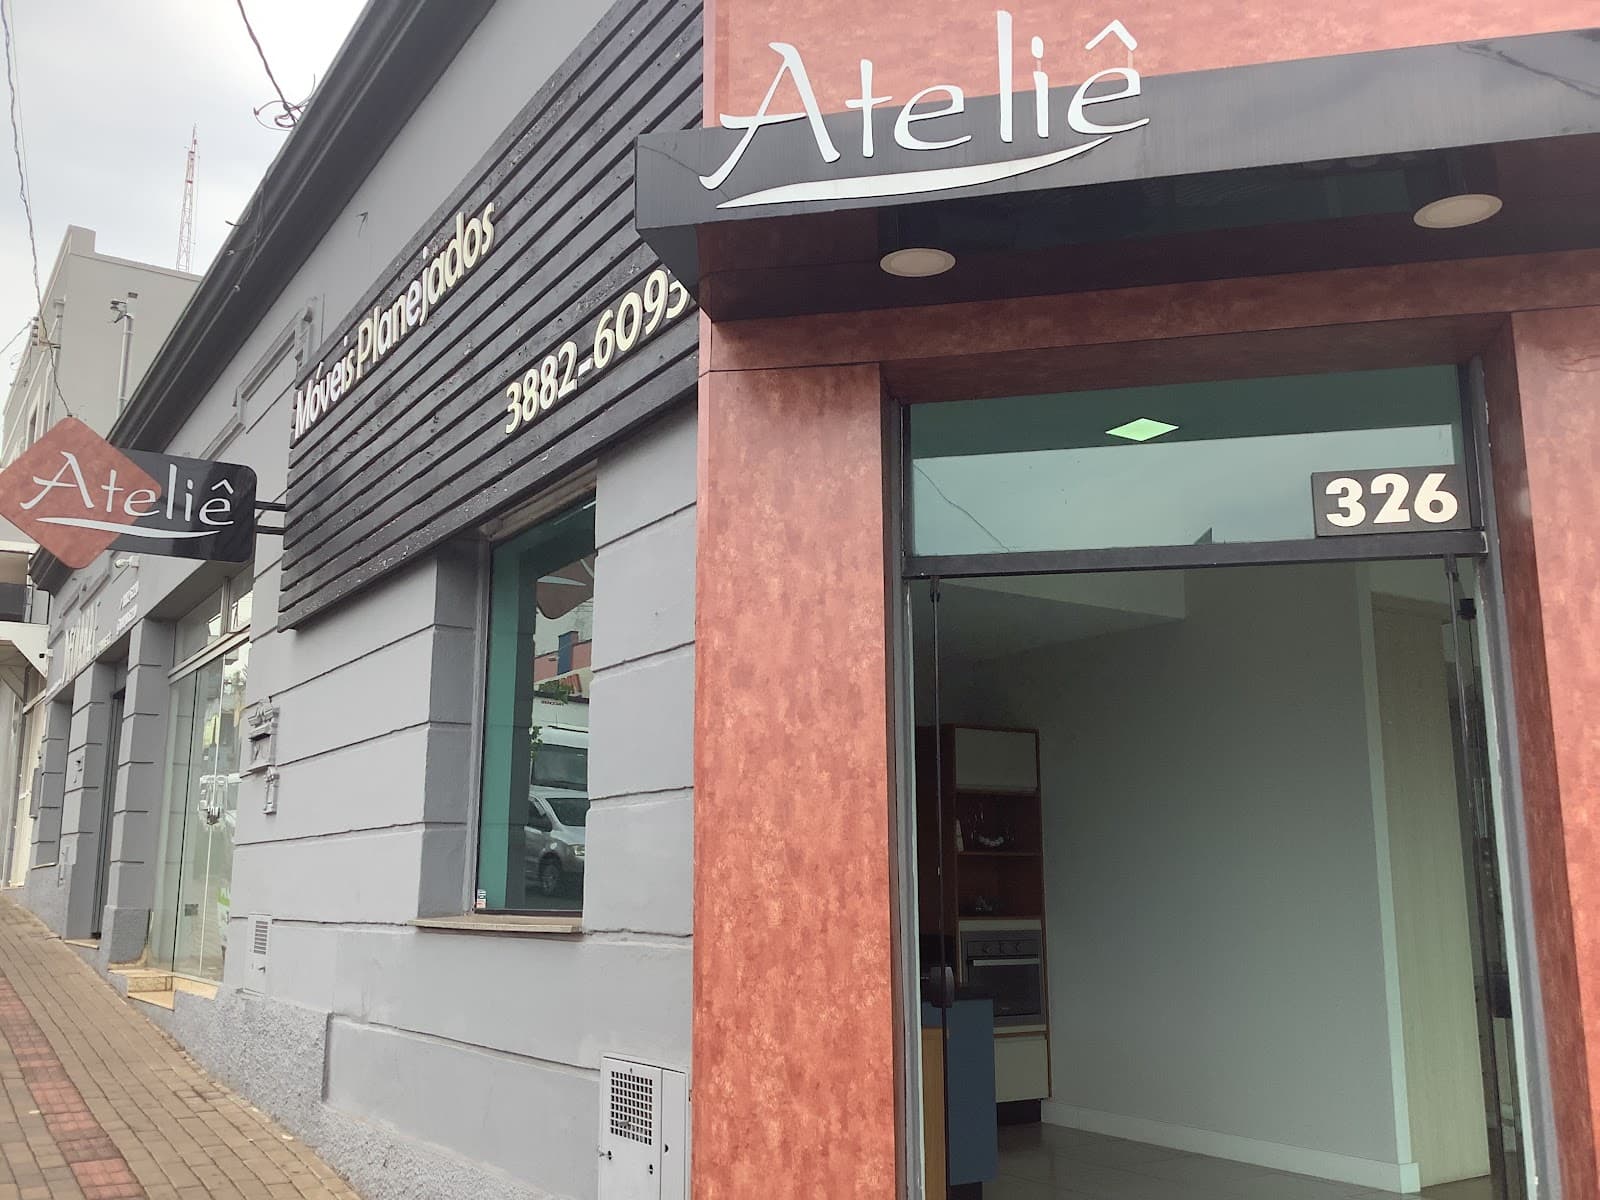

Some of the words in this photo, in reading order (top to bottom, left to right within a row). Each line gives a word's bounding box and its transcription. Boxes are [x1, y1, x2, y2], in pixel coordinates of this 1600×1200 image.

[699, 10, 1149, 190] Ateliê
[295, 336, 356, 440] Móveis
[357, 202, 495, 380] Planejados
[20, 451, 235, 526] Ateliê
[1325, 473, 1458, 527] 326
